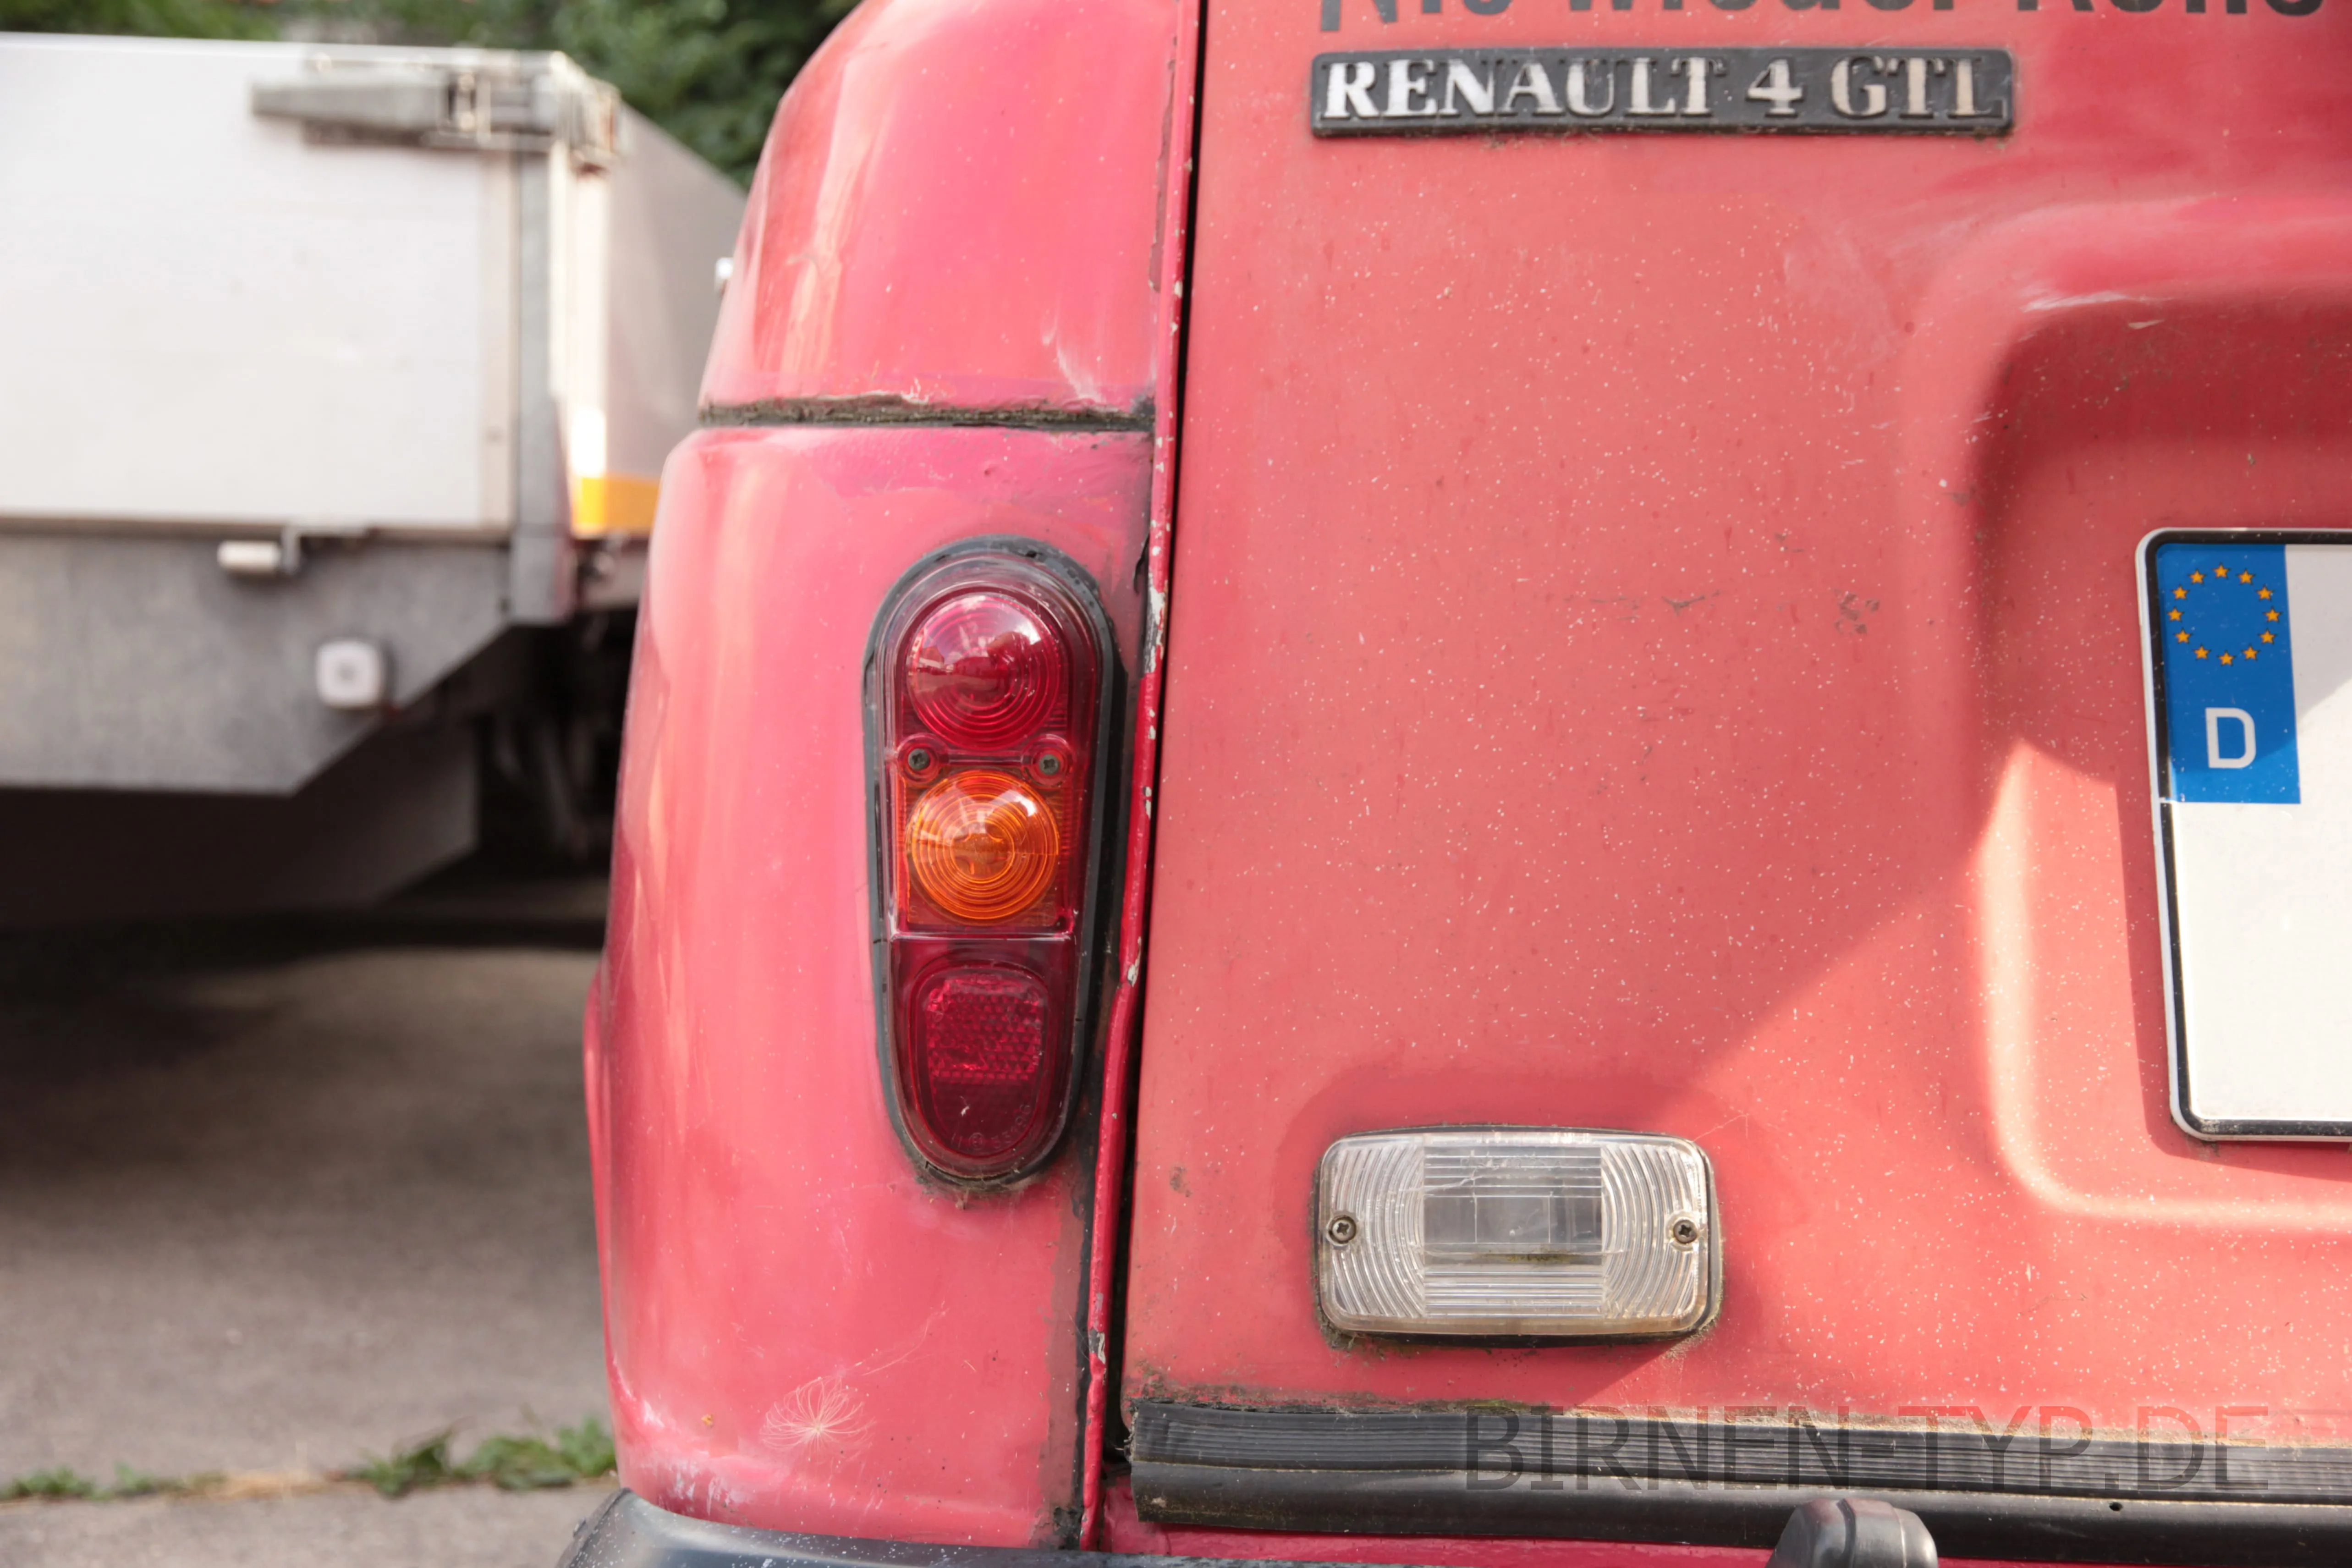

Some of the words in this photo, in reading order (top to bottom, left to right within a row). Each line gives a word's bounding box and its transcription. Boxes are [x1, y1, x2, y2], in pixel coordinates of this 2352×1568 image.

[1323, 56, 1726, 118] RENAULT
[1745, 58, 1803, 117] 4
[1831, 55, 2005, 119] GTL
[2205, 707, 2257, 769] D
